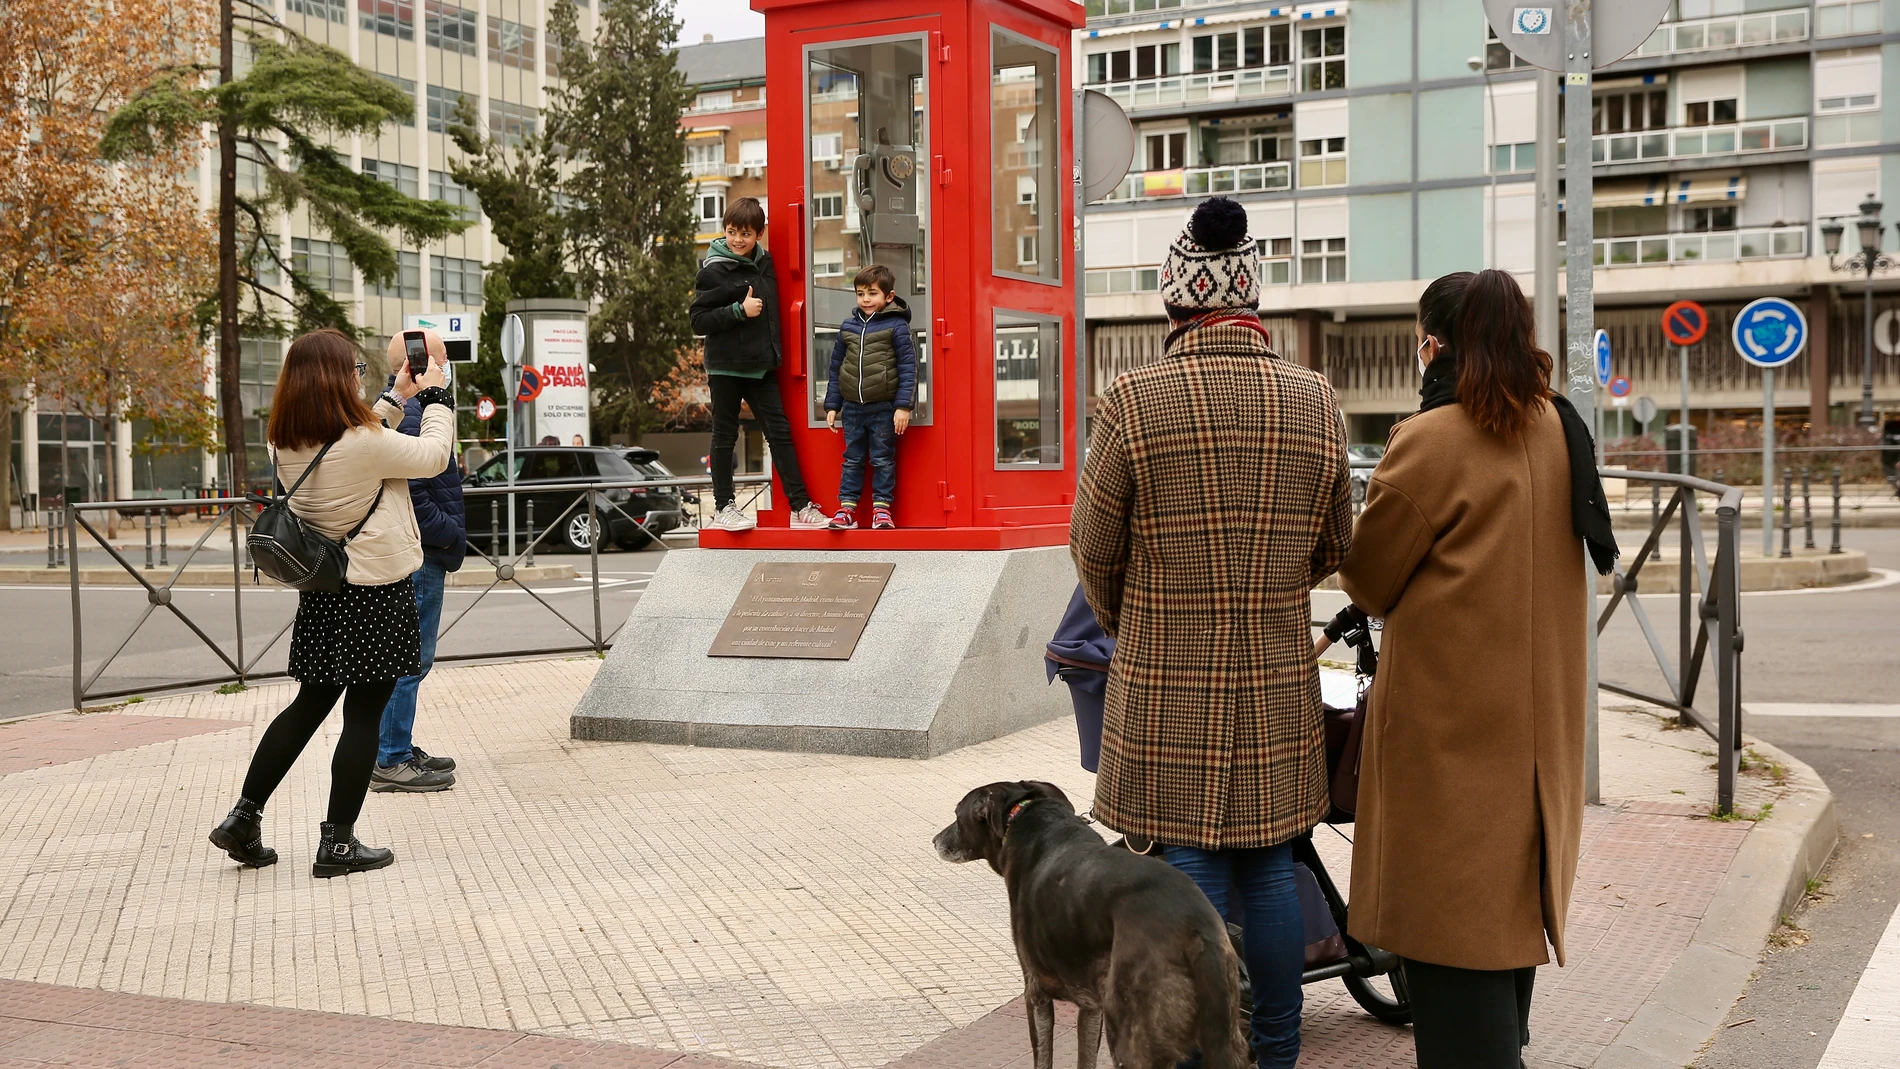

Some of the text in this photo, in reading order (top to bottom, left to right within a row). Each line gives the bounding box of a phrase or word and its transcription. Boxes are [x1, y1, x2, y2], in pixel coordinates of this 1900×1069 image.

[452, 319, 459, 331] P
[543, 363, 584, 376] MAMÁ
[542, 376, 551, 387] O
